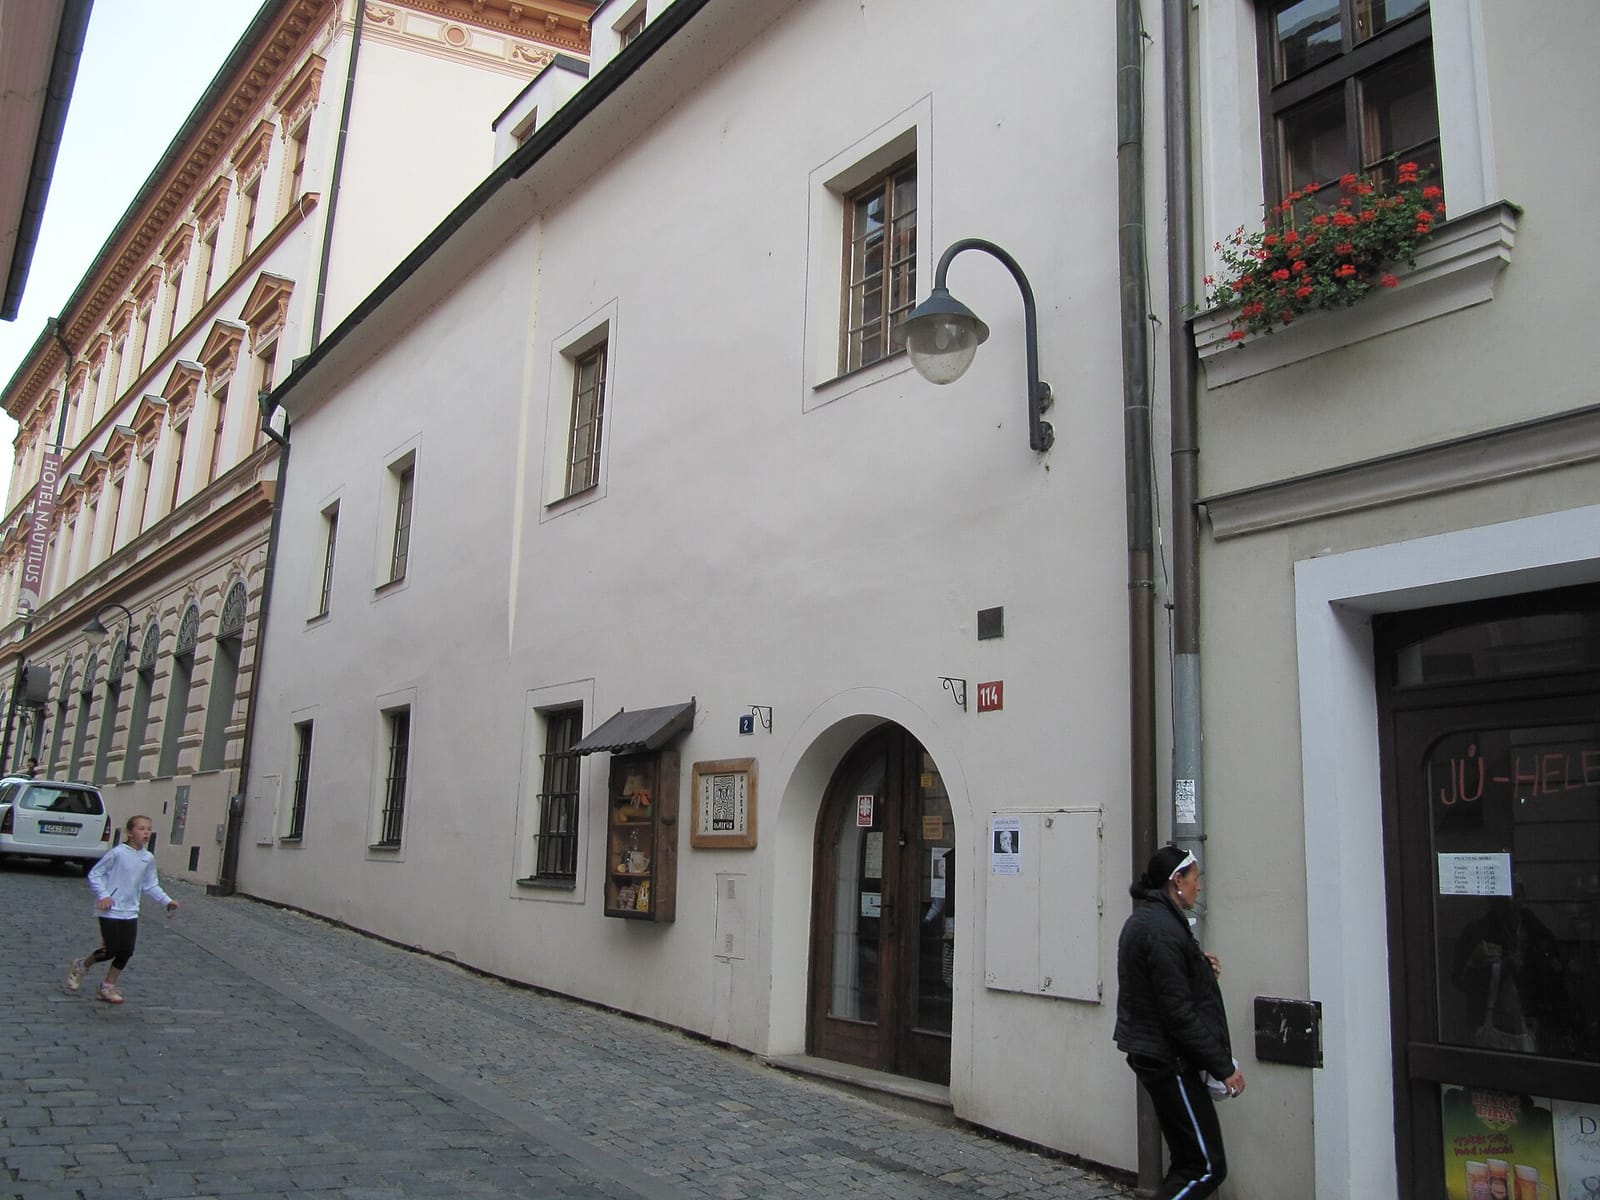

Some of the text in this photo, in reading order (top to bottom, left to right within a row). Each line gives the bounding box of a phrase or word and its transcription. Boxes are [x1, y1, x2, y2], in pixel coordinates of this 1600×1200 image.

[25, 459, 58, 584] HOTEL NAUTILUS
[980, 686, 998, 707] 114
